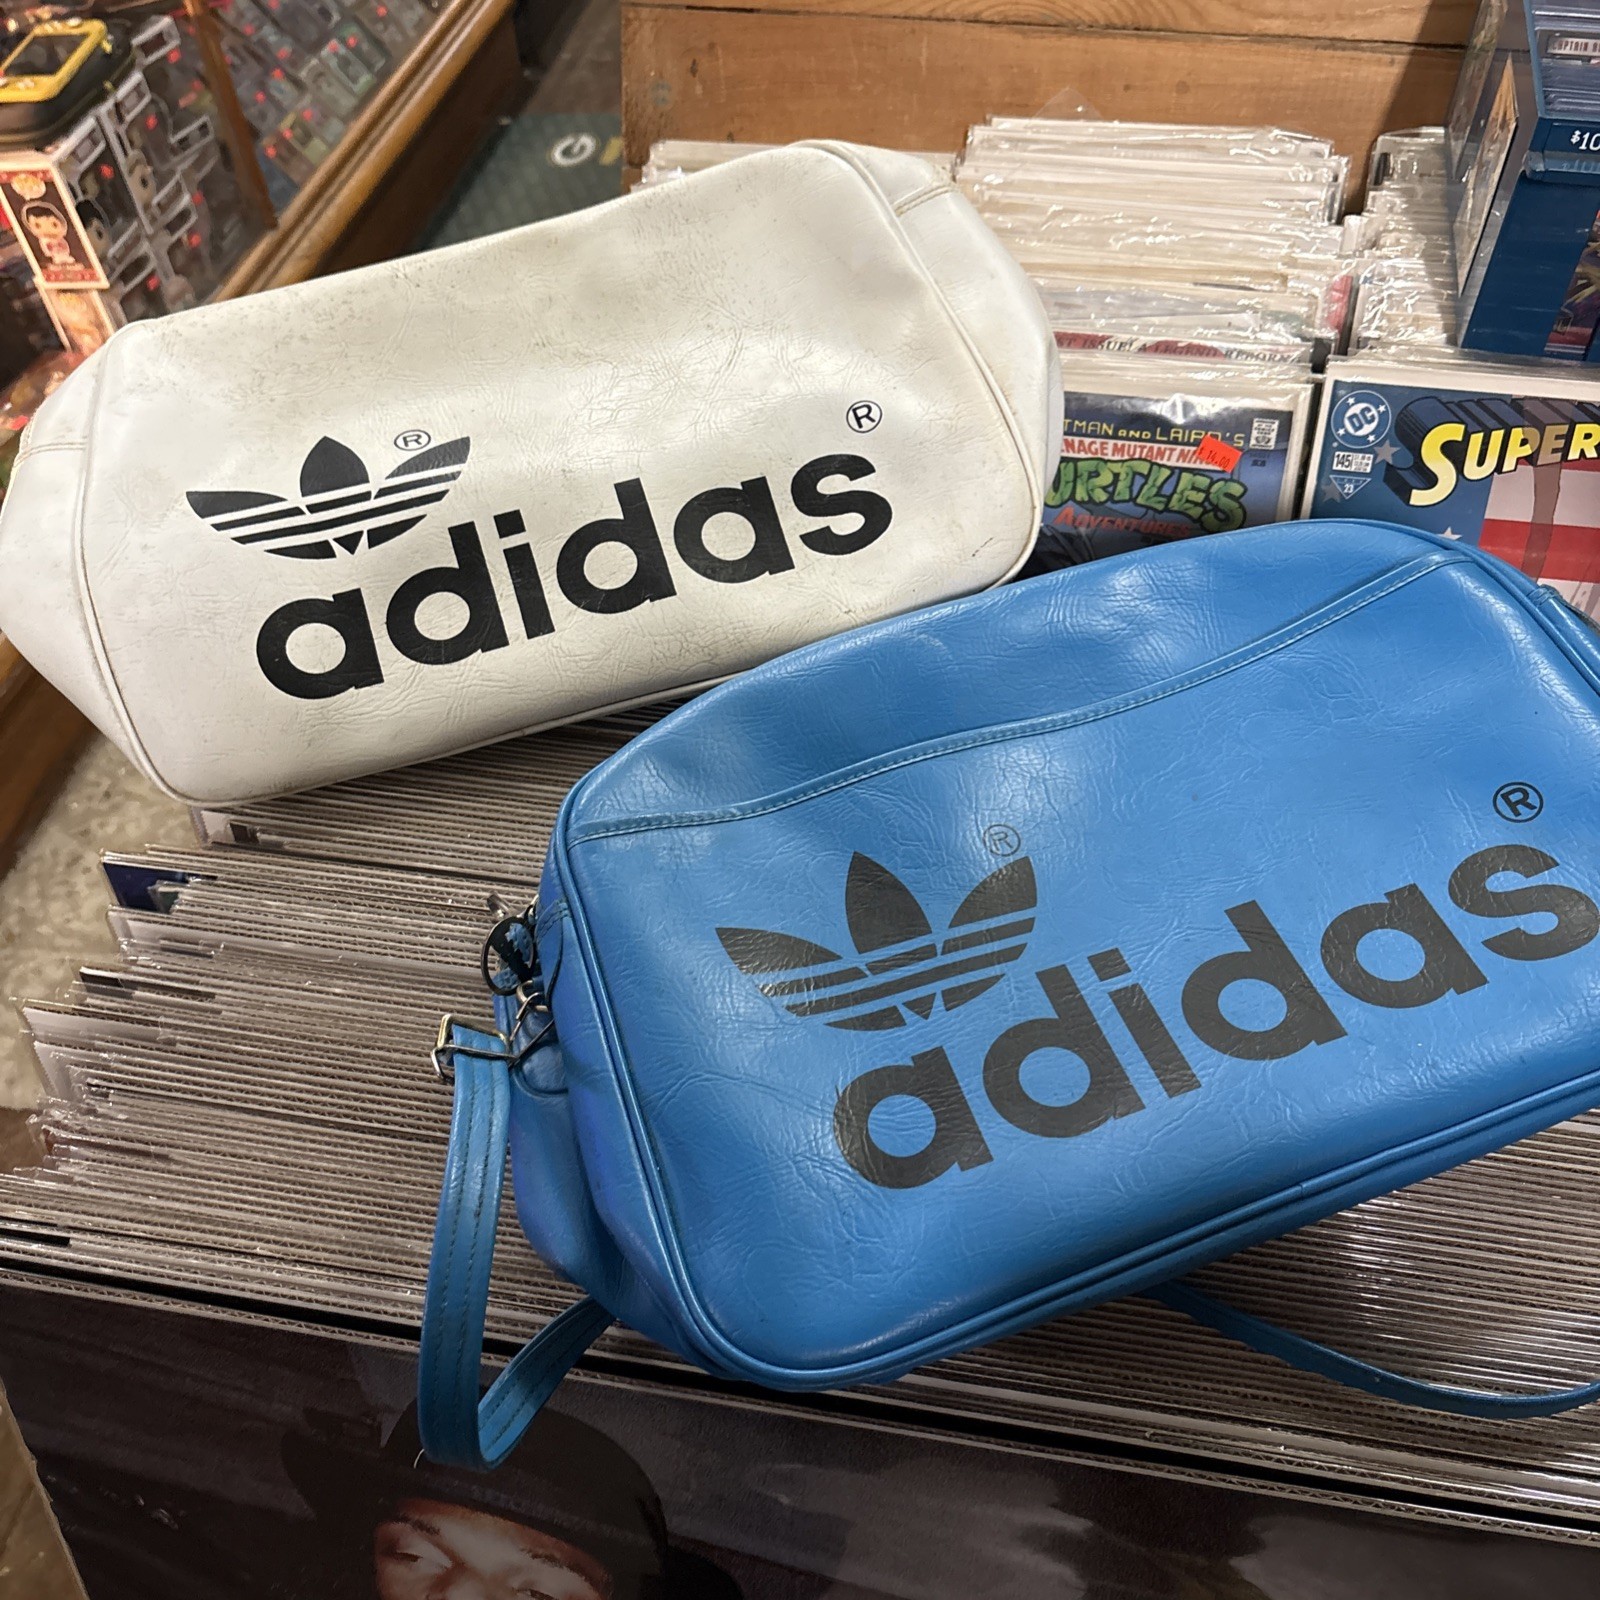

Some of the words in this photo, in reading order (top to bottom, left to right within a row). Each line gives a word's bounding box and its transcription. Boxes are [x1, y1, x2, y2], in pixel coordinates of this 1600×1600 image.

[1347, 406, 1377, 433] DC
[1061, 438, 1109, 457] NAGE
[1111, 442, 1174, 463] MUTANT
[1335, 453, 1352, 469] 145
[1408, 422, 1600, 507] SUPER
[1053, 505, 1193, 537] ADVENTURES
[256, 452, 893, 700] adidas
[833, 843, 1600, 1189] adidas
